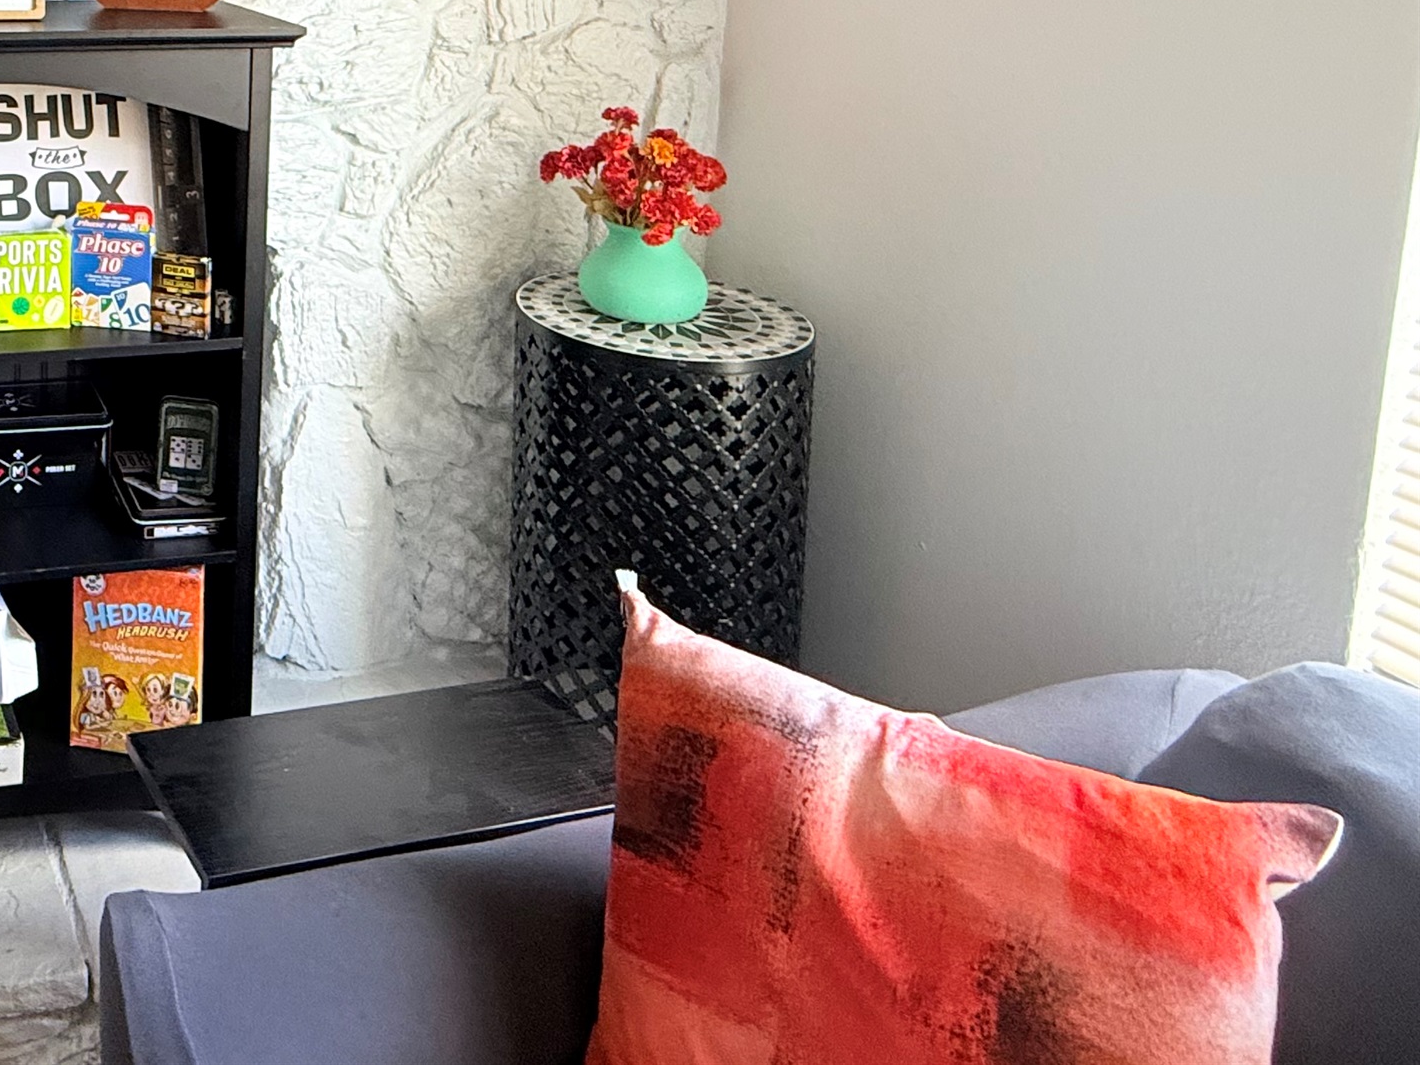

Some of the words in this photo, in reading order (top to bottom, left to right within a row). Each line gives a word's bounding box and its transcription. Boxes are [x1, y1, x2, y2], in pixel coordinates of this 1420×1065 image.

[44, 149, 72, 164] the
[185, 190, 200, 200] 3
[78, 232, 145, 256] Phase
[98, 256, 122, 274] 10
[164, 266, 192, 275] DEAL
[108, 311, 123, 328] 8
[123, 303, 151, 327] 10
[83, 601, 194, 633] HEDBANZ
[116, 625, 188, 641] HEADRUSH
[102, 641, 128, 653] Quick
